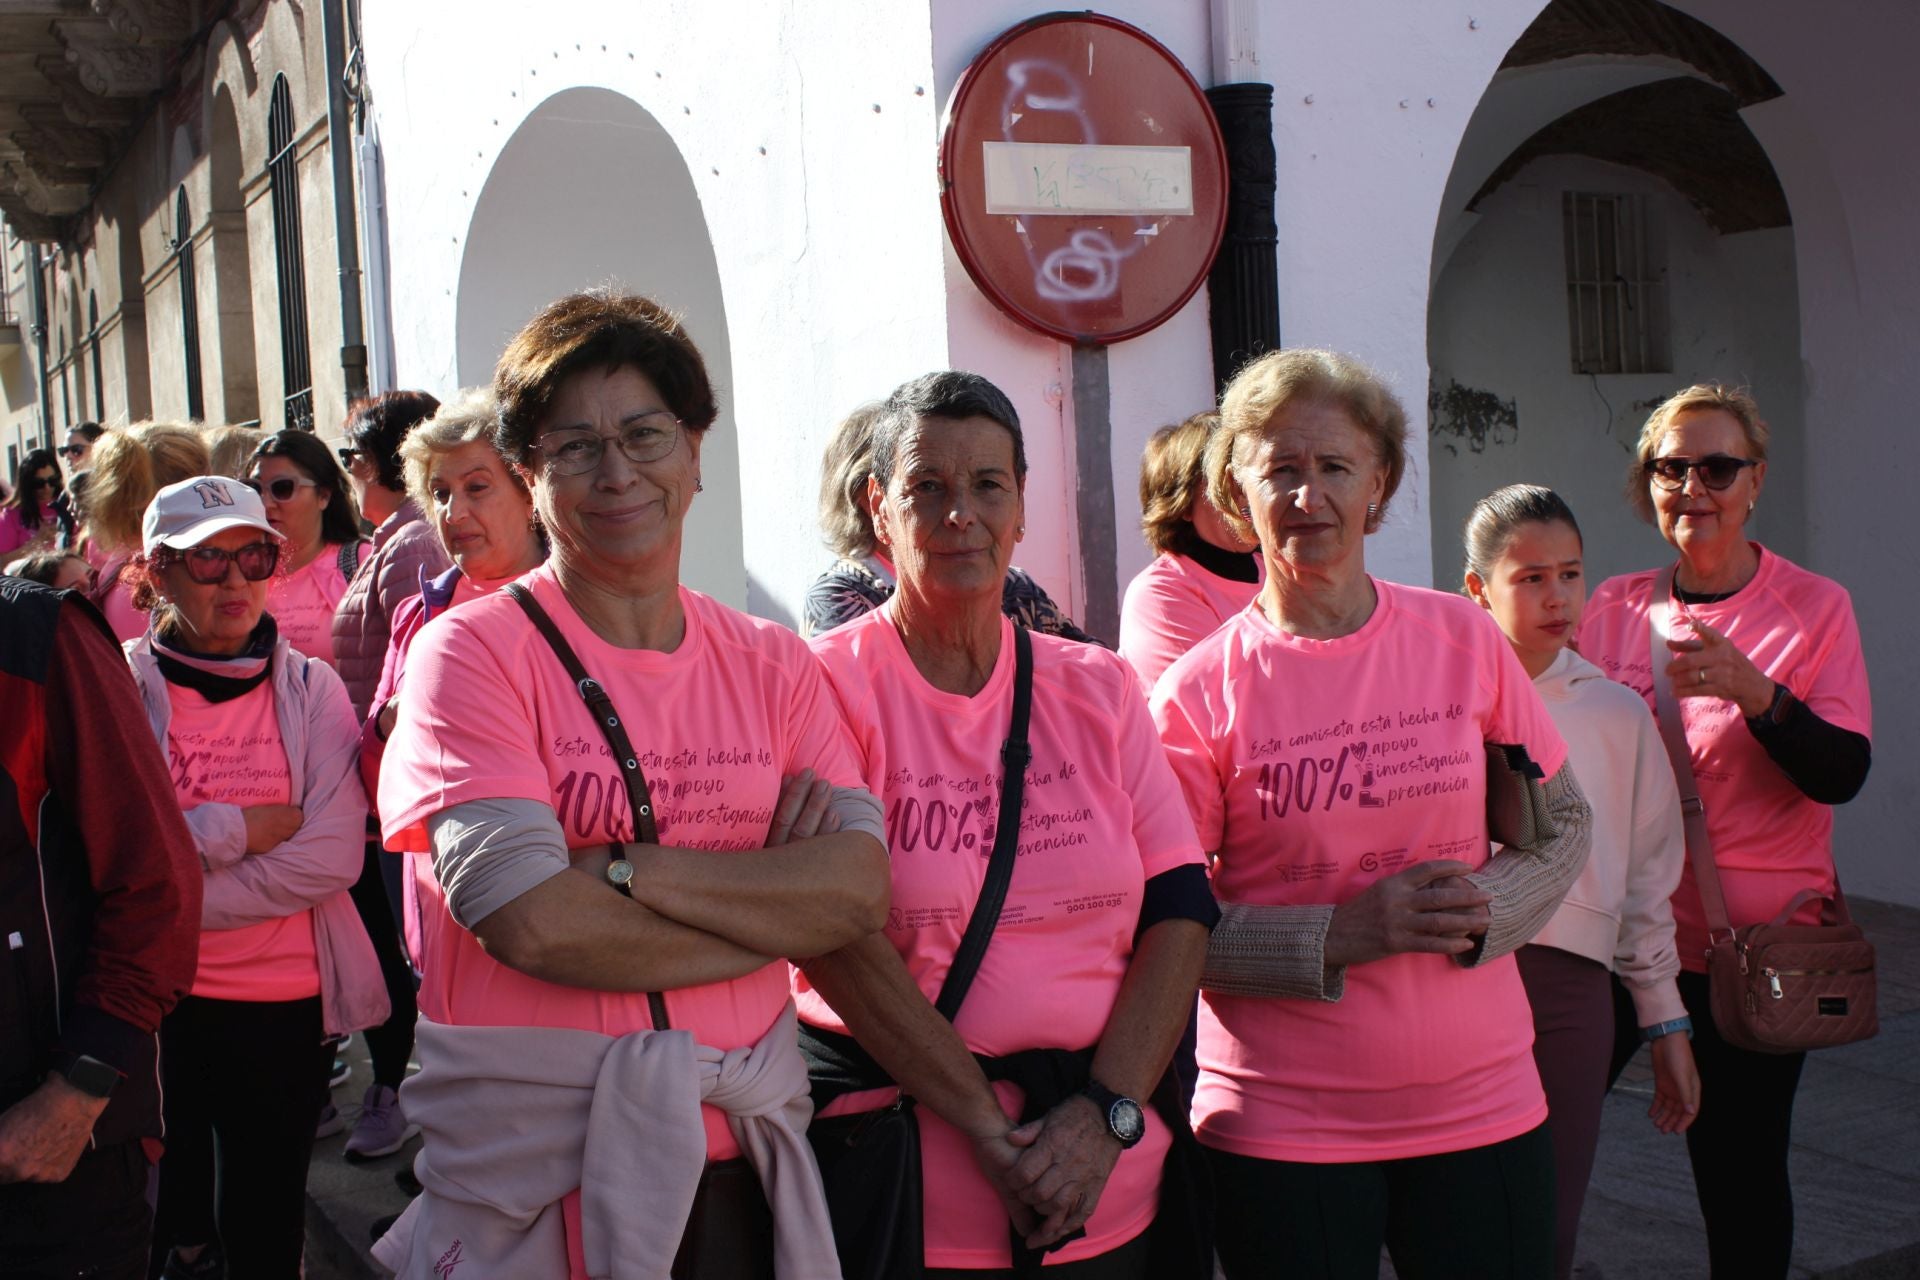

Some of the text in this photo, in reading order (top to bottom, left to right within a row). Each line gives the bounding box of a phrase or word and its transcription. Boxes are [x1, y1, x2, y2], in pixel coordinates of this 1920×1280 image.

[193, 480, 235, 510] N
[1249, 704, 1463, 760] Esta camiseta está hecha de
[553, 736, 591, 757] Esta
[664, 748, 697, 771] está
[707, 747, 752, 767] hecha
[757, 749, 773, 767] de
[1372, 737, 1418, 757] apoyo
[214, 754, 250, 767] apoyo
[1060, 761, 1077, 780] de
[1376, 749, 1472, 778] investigación
[211, 766, 290, 782] investigación
[1257, 746, 1353, 821] 100%
[213, 786, 280, 800] prevención
[673, 778, 725, 800] apoyo
[1387, 776, 1469, 807] prevención
[671, 803, 772, 829] investigación
[887, 797, 976, 854] 100%
[1017, 831, 1088, 857] evención
[1067, 905, 1085, 914] 900
[1087, 900, 1104, 910] 100
